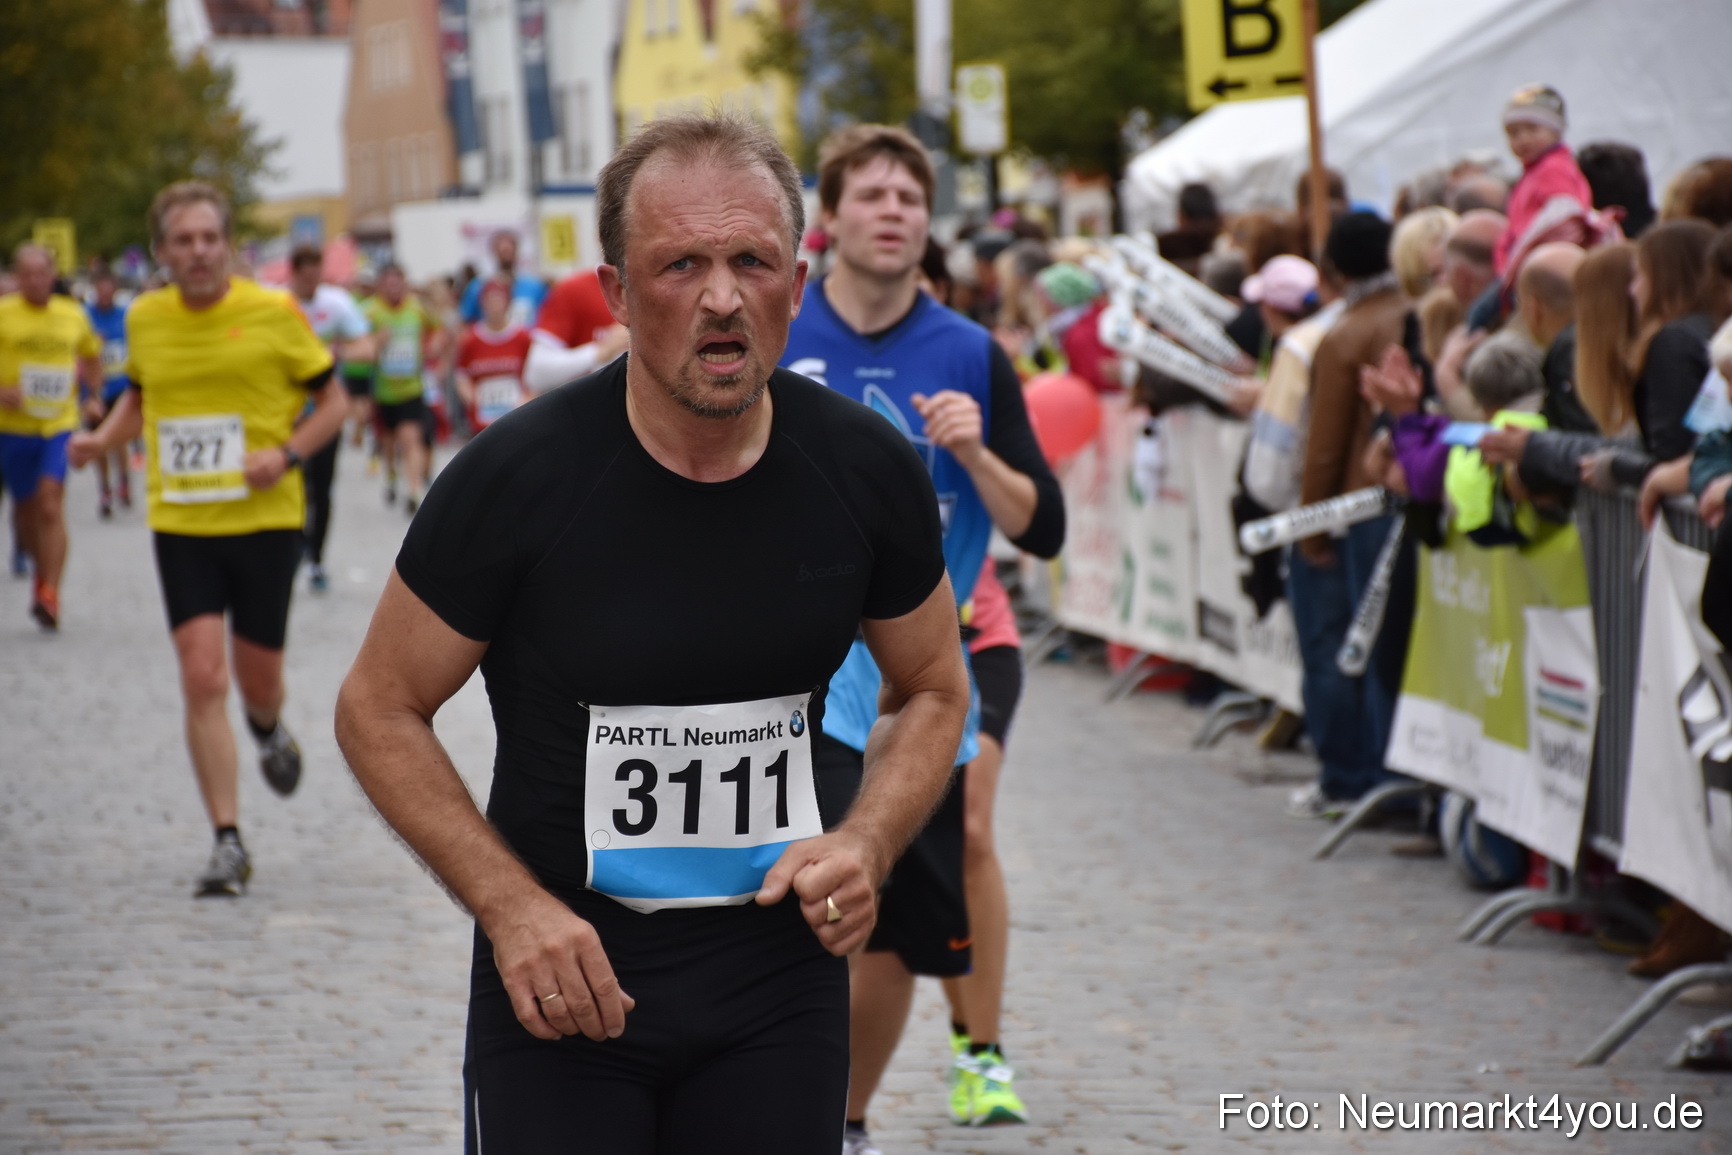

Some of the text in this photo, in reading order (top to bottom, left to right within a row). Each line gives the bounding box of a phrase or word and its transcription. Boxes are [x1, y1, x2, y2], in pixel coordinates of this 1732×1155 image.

[1222, 0, 1282, 58] B
[171, 437, 223, 470] 227
[595, 720, 783, 747] PARTL Neumarkt
[612, 749, 789, 836] 3111
